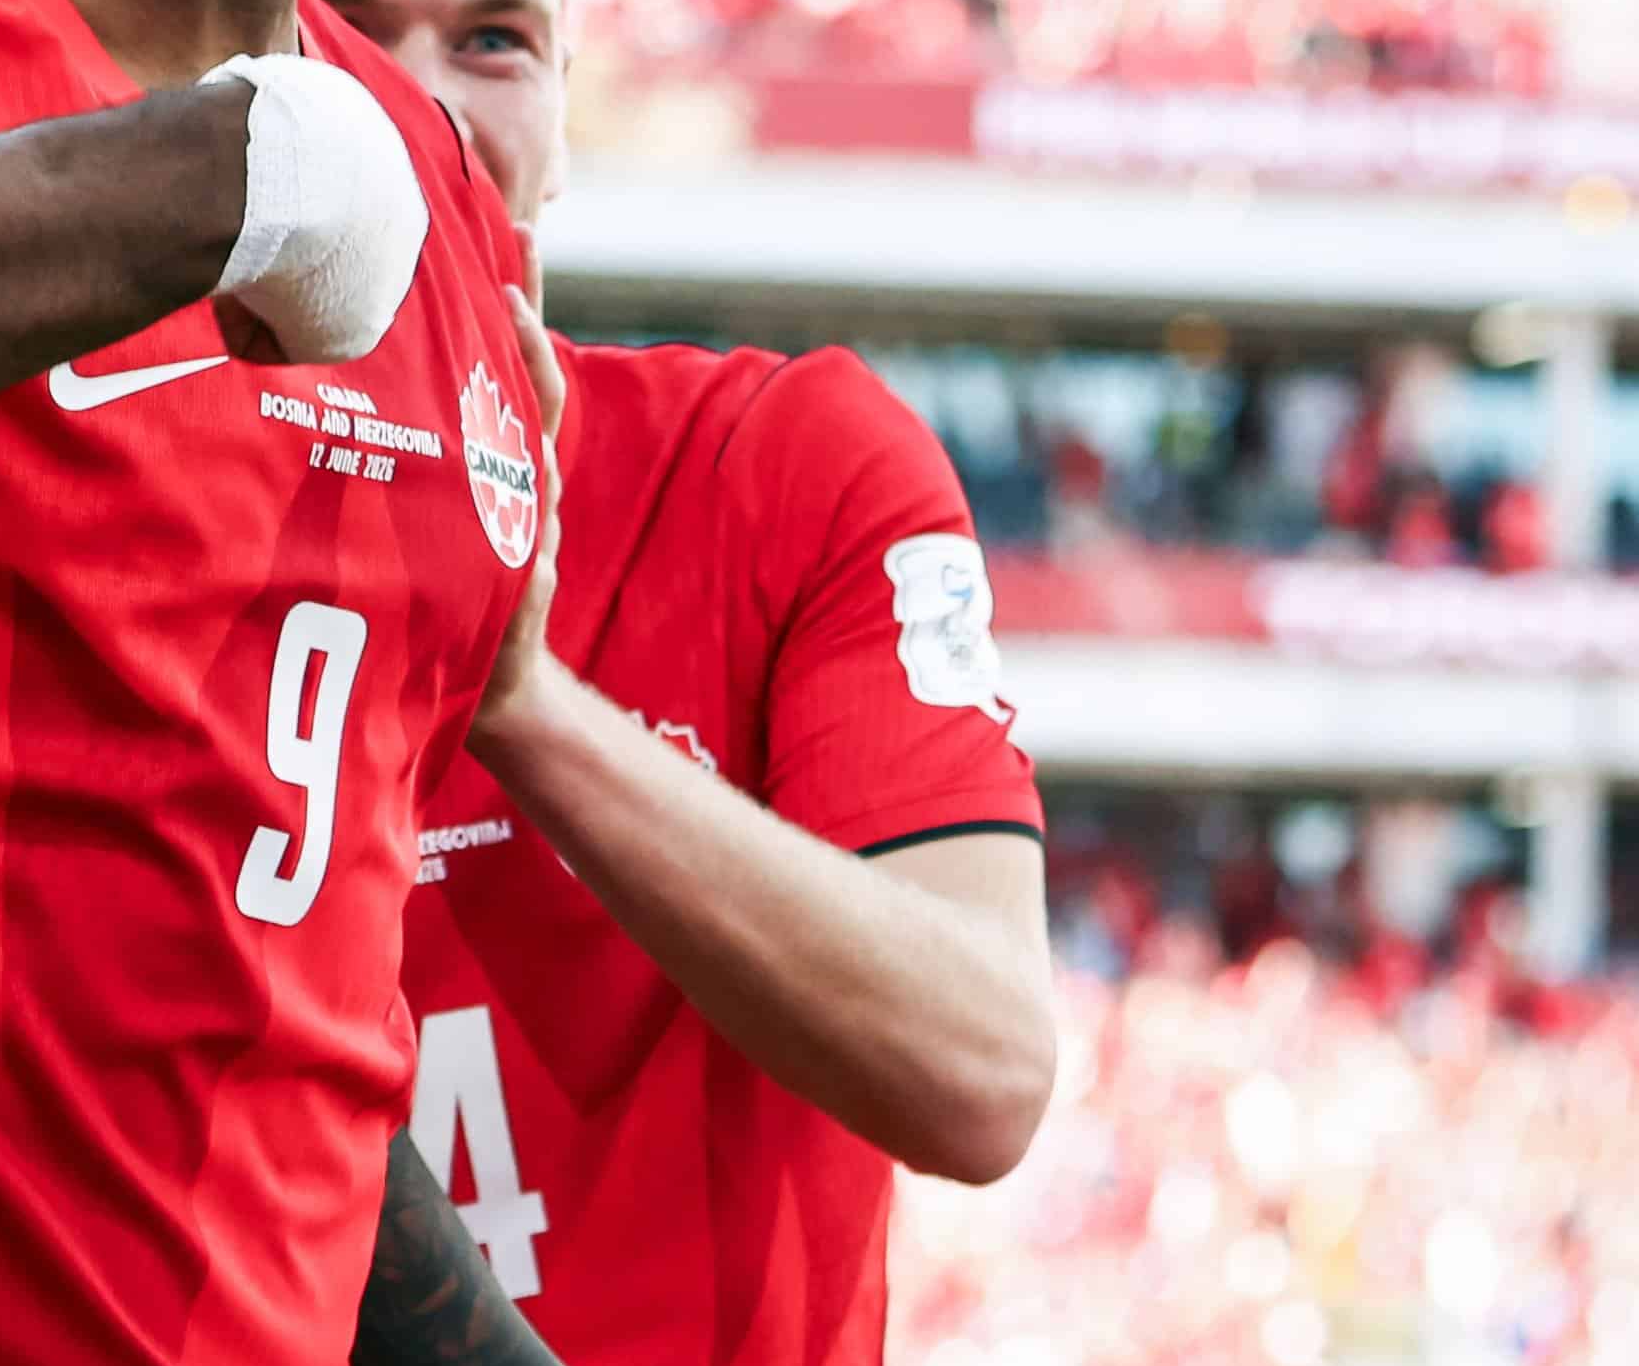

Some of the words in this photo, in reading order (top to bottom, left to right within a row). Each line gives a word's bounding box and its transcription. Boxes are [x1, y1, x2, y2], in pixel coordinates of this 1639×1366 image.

[260, 391, 318, 431] BOSNIA
[321, 408, 351, 437] AND
[354, 415, 442, 459] HERZEGOVINA
[309, 442, 325, 468] 12
[326, 446, 362, 476] JUNE
[363, 453, 397, 483] 2026
[467, 445, 533, 496] CANADA
[234, 600, 368, 926] 9
[409, 1003, 550, 1300] 4
